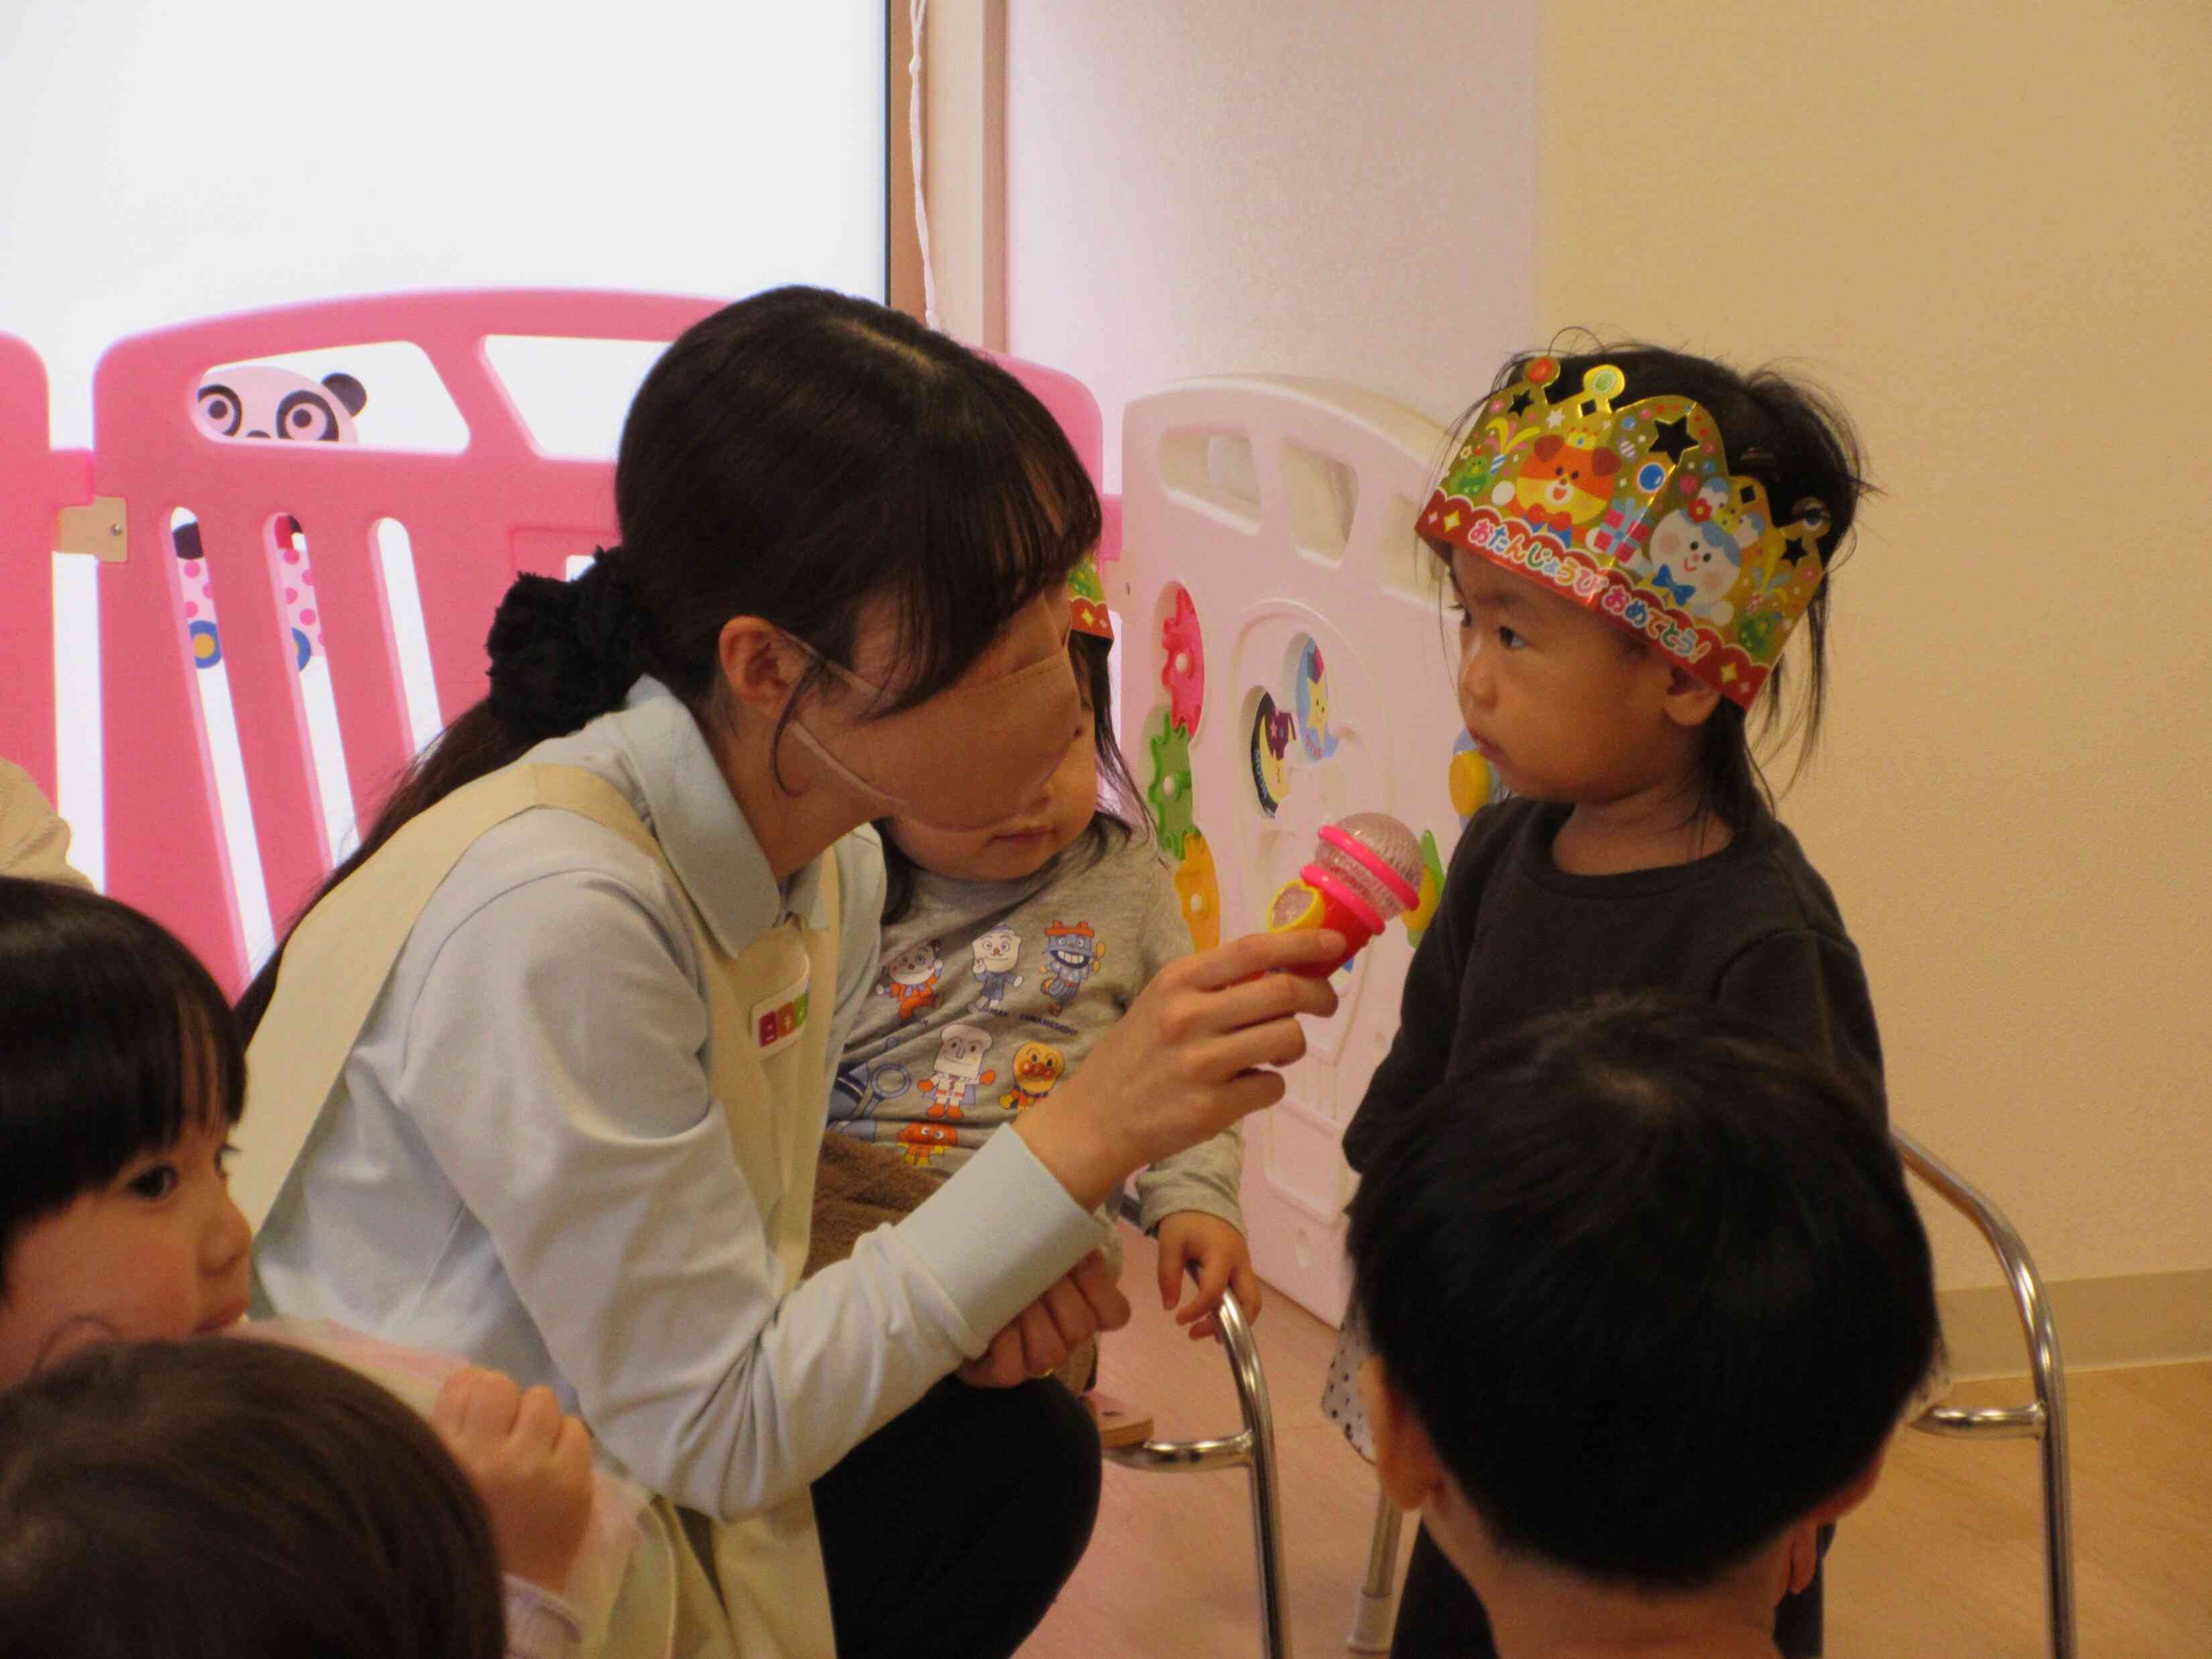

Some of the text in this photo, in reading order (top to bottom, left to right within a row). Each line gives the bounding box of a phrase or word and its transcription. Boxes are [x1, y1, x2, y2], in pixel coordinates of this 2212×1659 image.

[1468, 518, 1609, 597] おたんじょうび
